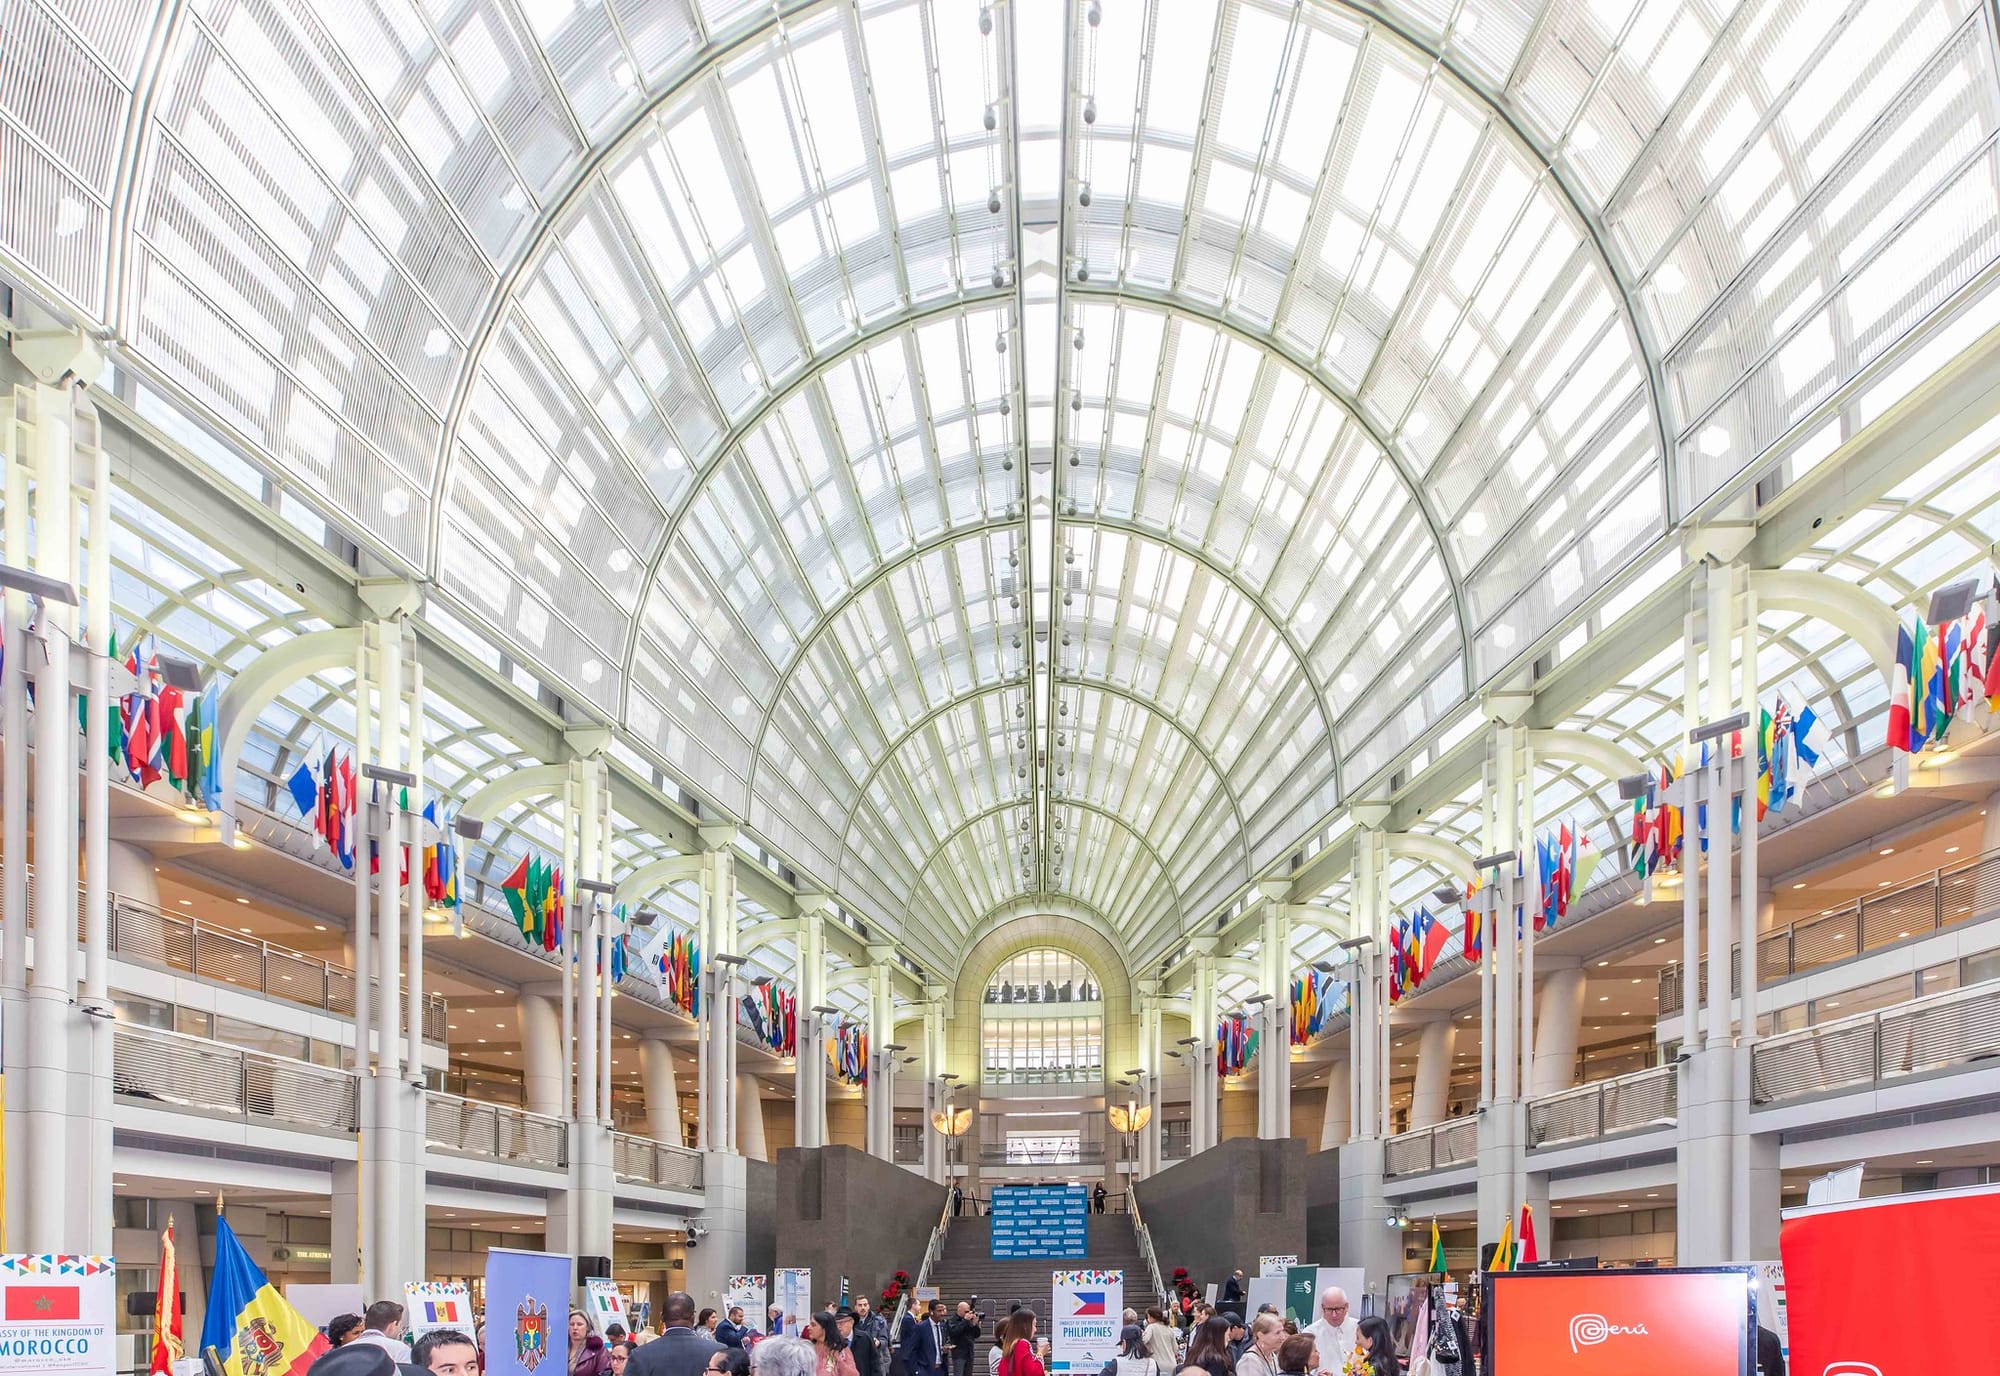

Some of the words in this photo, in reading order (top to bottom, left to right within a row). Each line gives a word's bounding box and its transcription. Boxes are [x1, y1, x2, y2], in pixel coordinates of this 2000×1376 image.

[20, 1329, 32, 1337] OF
[34, 1328, 49, 1337] THE
[52, 1327, 92, 1337] KINGDOM
[94, 1327, 105, 1336] OF
[1063, 1327, 1112, 1337] PHILIPPINES
[0, 1338, 89, 1356] MOROCCO
